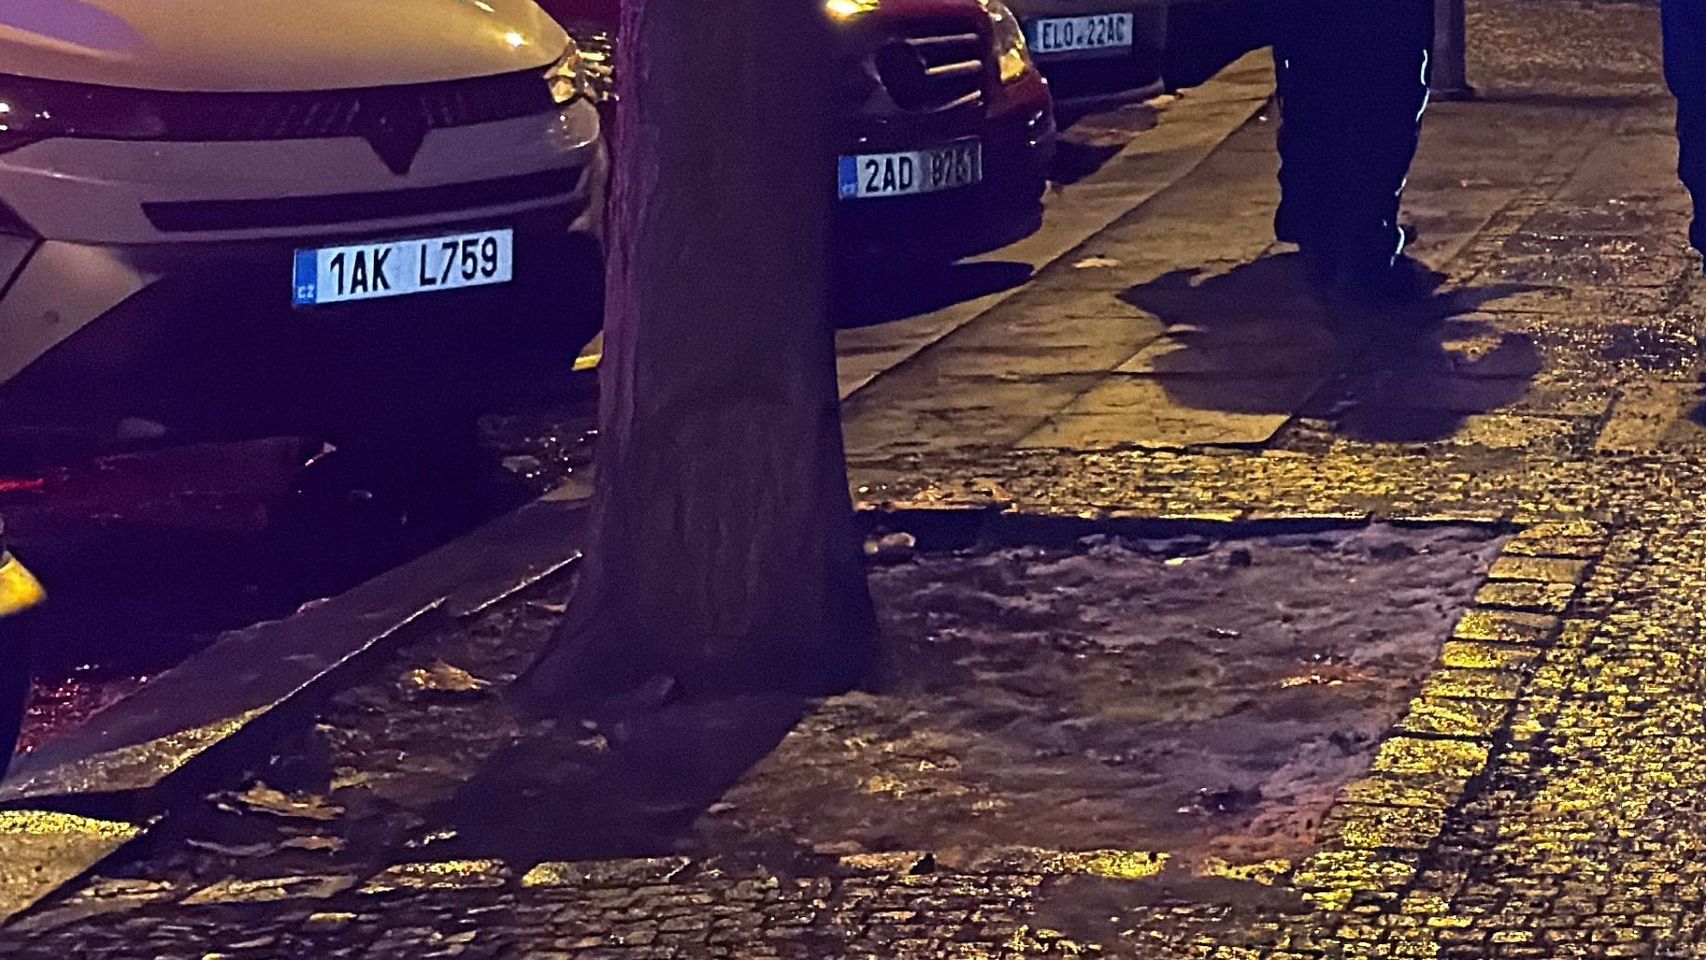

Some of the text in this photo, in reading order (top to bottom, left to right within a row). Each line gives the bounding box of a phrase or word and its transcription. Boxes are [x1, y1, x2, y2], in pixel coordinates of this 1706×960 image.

[1043, 22, 1073, 50] ELO
[865, 156, 913, 192] 2AD
[297, 237, 498, 299] CZ 1AK L759
